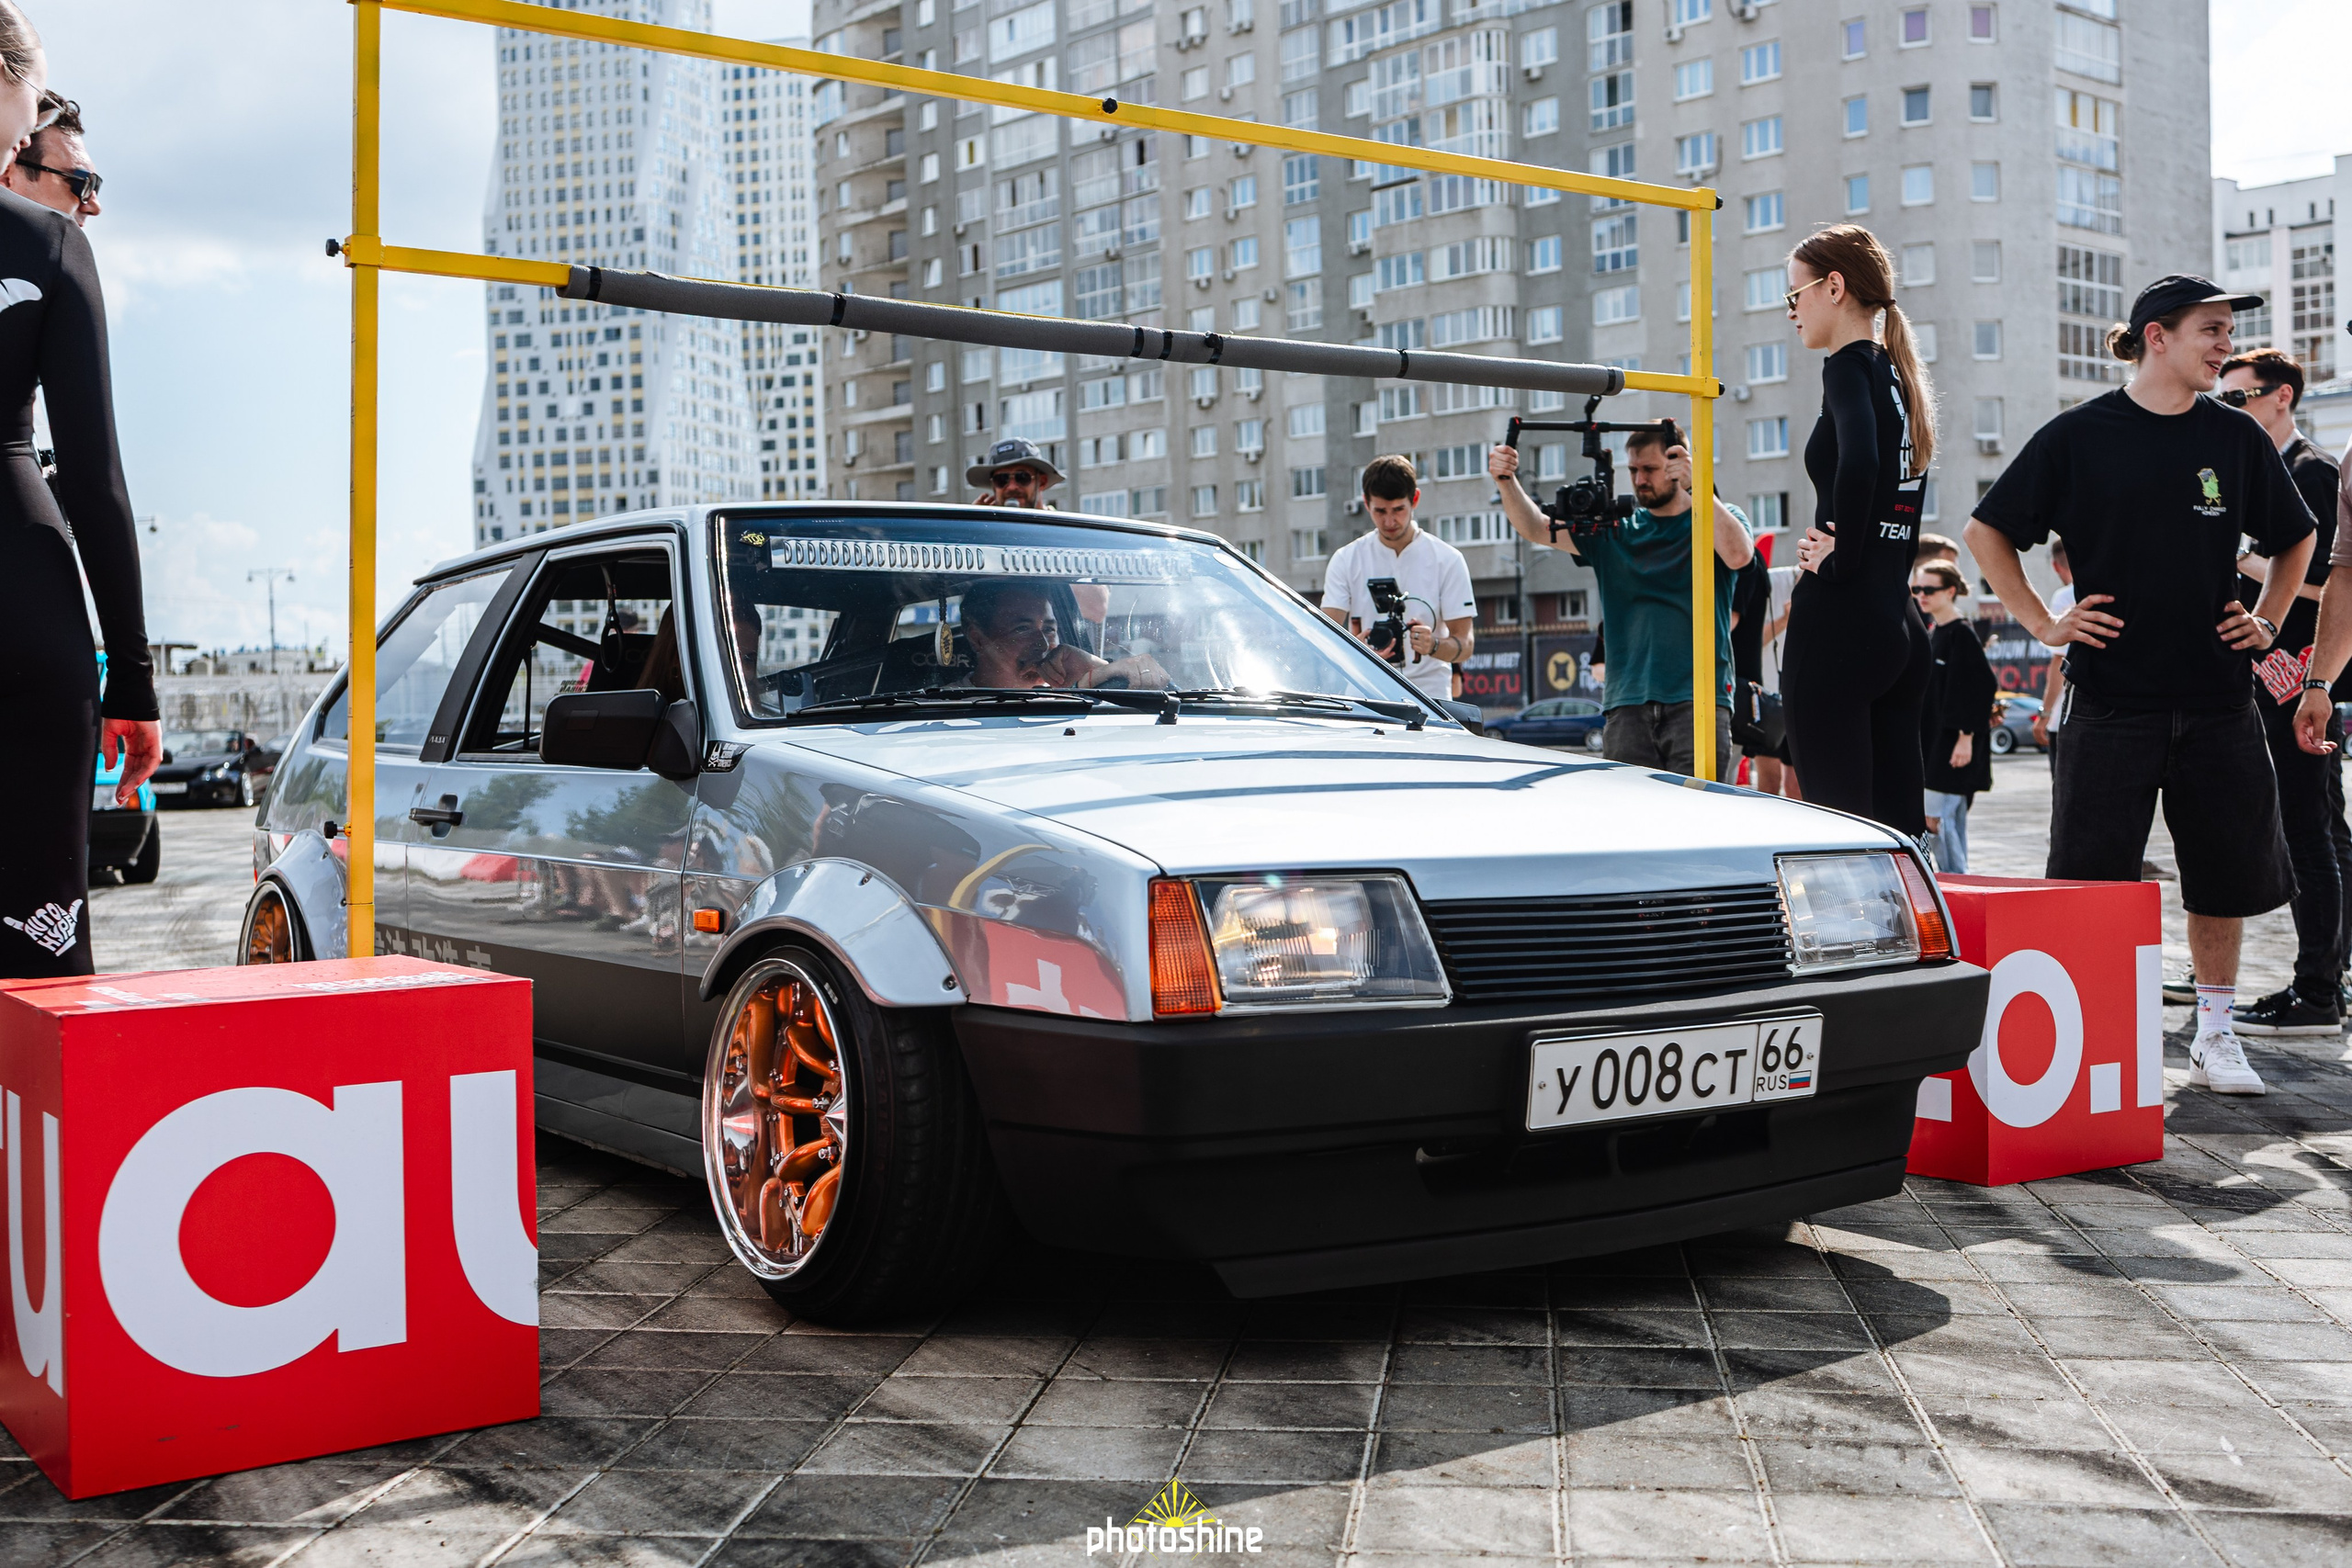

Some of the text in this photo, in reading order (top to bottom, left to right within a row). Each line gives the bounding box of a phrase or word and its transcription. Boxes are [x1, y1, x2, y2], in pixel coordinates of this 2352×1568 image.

[24, 902, 62, 942] AUTO
[37, 913, 77, 952] HYPE
[1761, 1026, 1804, 1074] 66
[1756, 1073, 1787, 1093] RUS
